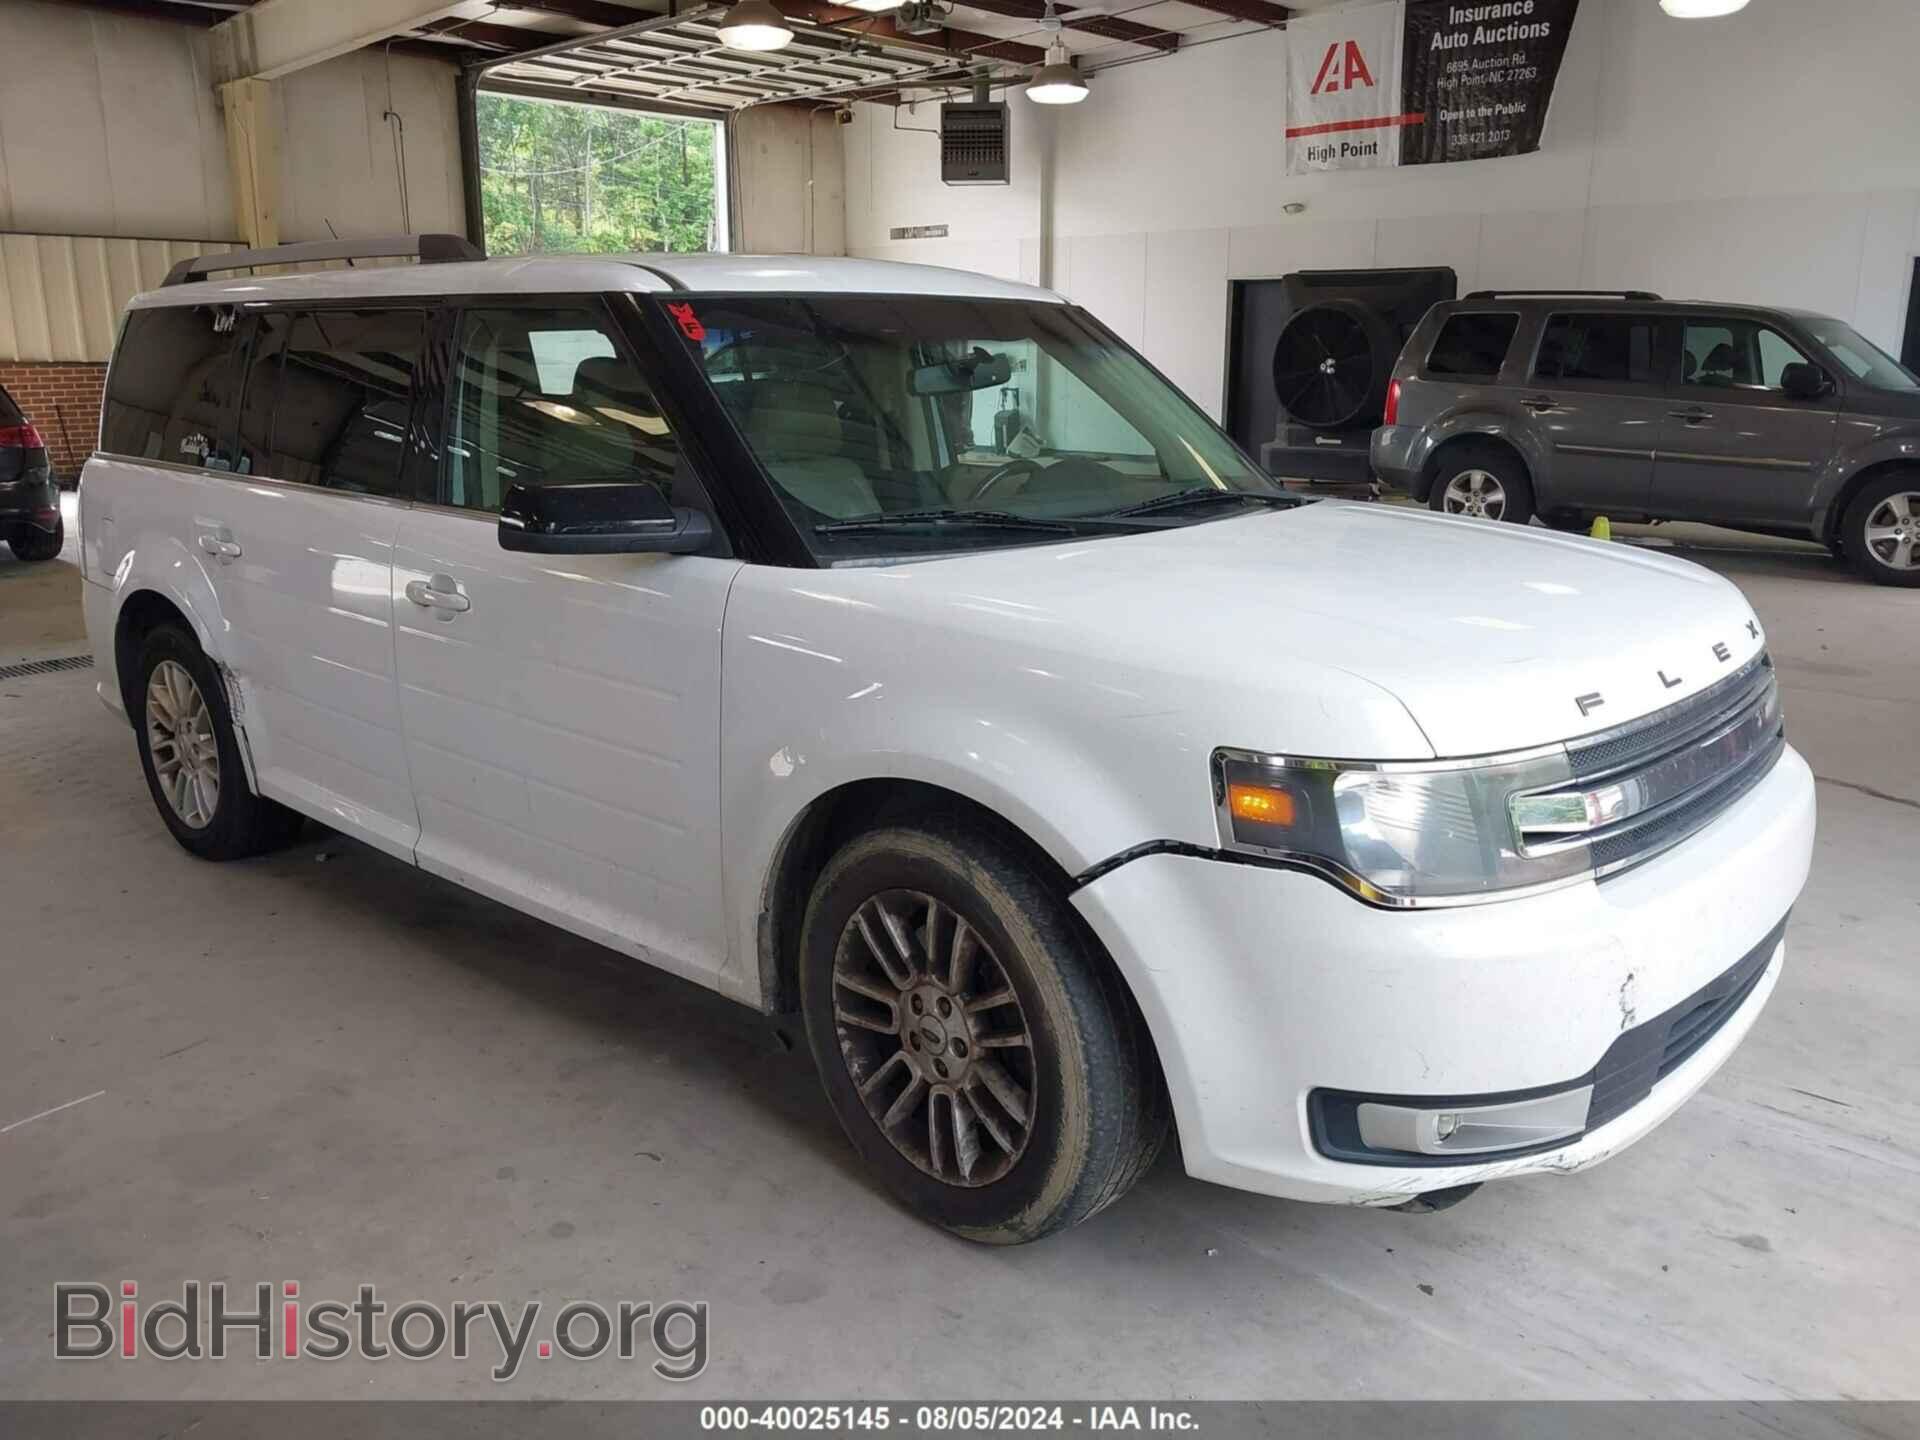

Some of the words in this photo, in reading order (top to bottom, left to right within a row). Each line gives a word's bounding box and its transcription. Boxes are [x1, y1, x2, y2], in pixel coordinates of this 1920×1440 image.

[1449, 0, 1534, 24] Insurance
[1430, 31, 1468, 51] Auto
[1472, 21, 1551, 45] Auctions
[1471, 57, 1510, 70] Auction
[1437, 76, 1458, 91] High
[1488, 70, 1505, 82] NC
[1440, 109, 1464, 122] Open
[1466, 108, 1475, 118] to
[1478, 105, 1493, 117] the
[1495, 102, 1527, 115] Public
[1307, 144, 1336, 162] High
[1341, 141, 1378, 158] Point
